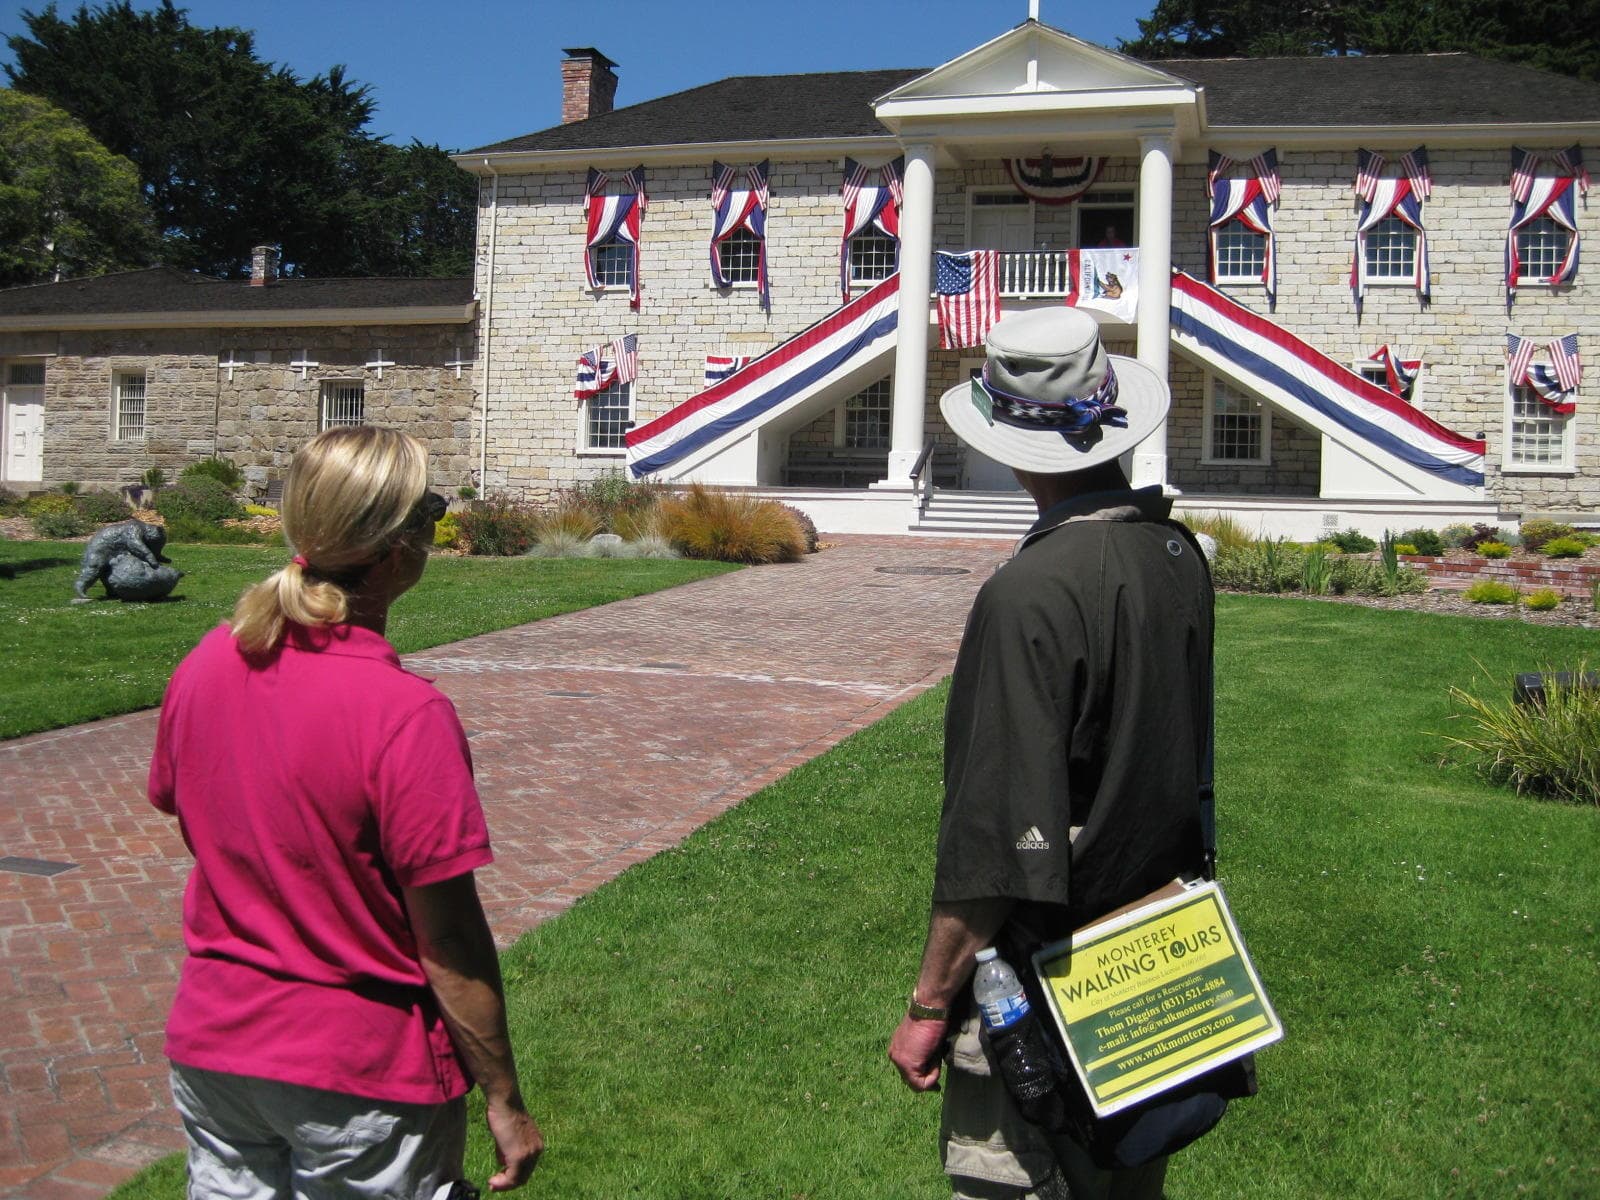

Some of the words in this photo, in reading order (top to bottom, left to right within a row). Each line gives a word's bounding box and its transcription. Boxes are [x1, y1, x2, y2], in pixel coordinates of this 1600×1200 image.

[1016, 840, 1050, 850] adidas
[1060, 953, 1156, 1003] WALKING
[1157, 925, 1222, 964] TOURS
[1097, 924, 1176, 968] MONTEREY
[1095, 1020, 1124, 1038] Thom
[1124, 1005, 1161, 1027] Diggins
[1160, 994, 1185, 1012] (831)
[1185, 976, 1225, 1000] 521-4884
[1098, 1033, 1129, 1052] e-mail:
[1130, 988, 1234, 1039] info@walkmonterey.com
[1108, 1003, 1131, 1019] Please
[1131, 998, 1145, 1009] call
[1145, 993, 1156, 1003] for
[1117, 1013, 1235, 1071] www.walkmonterey.com
